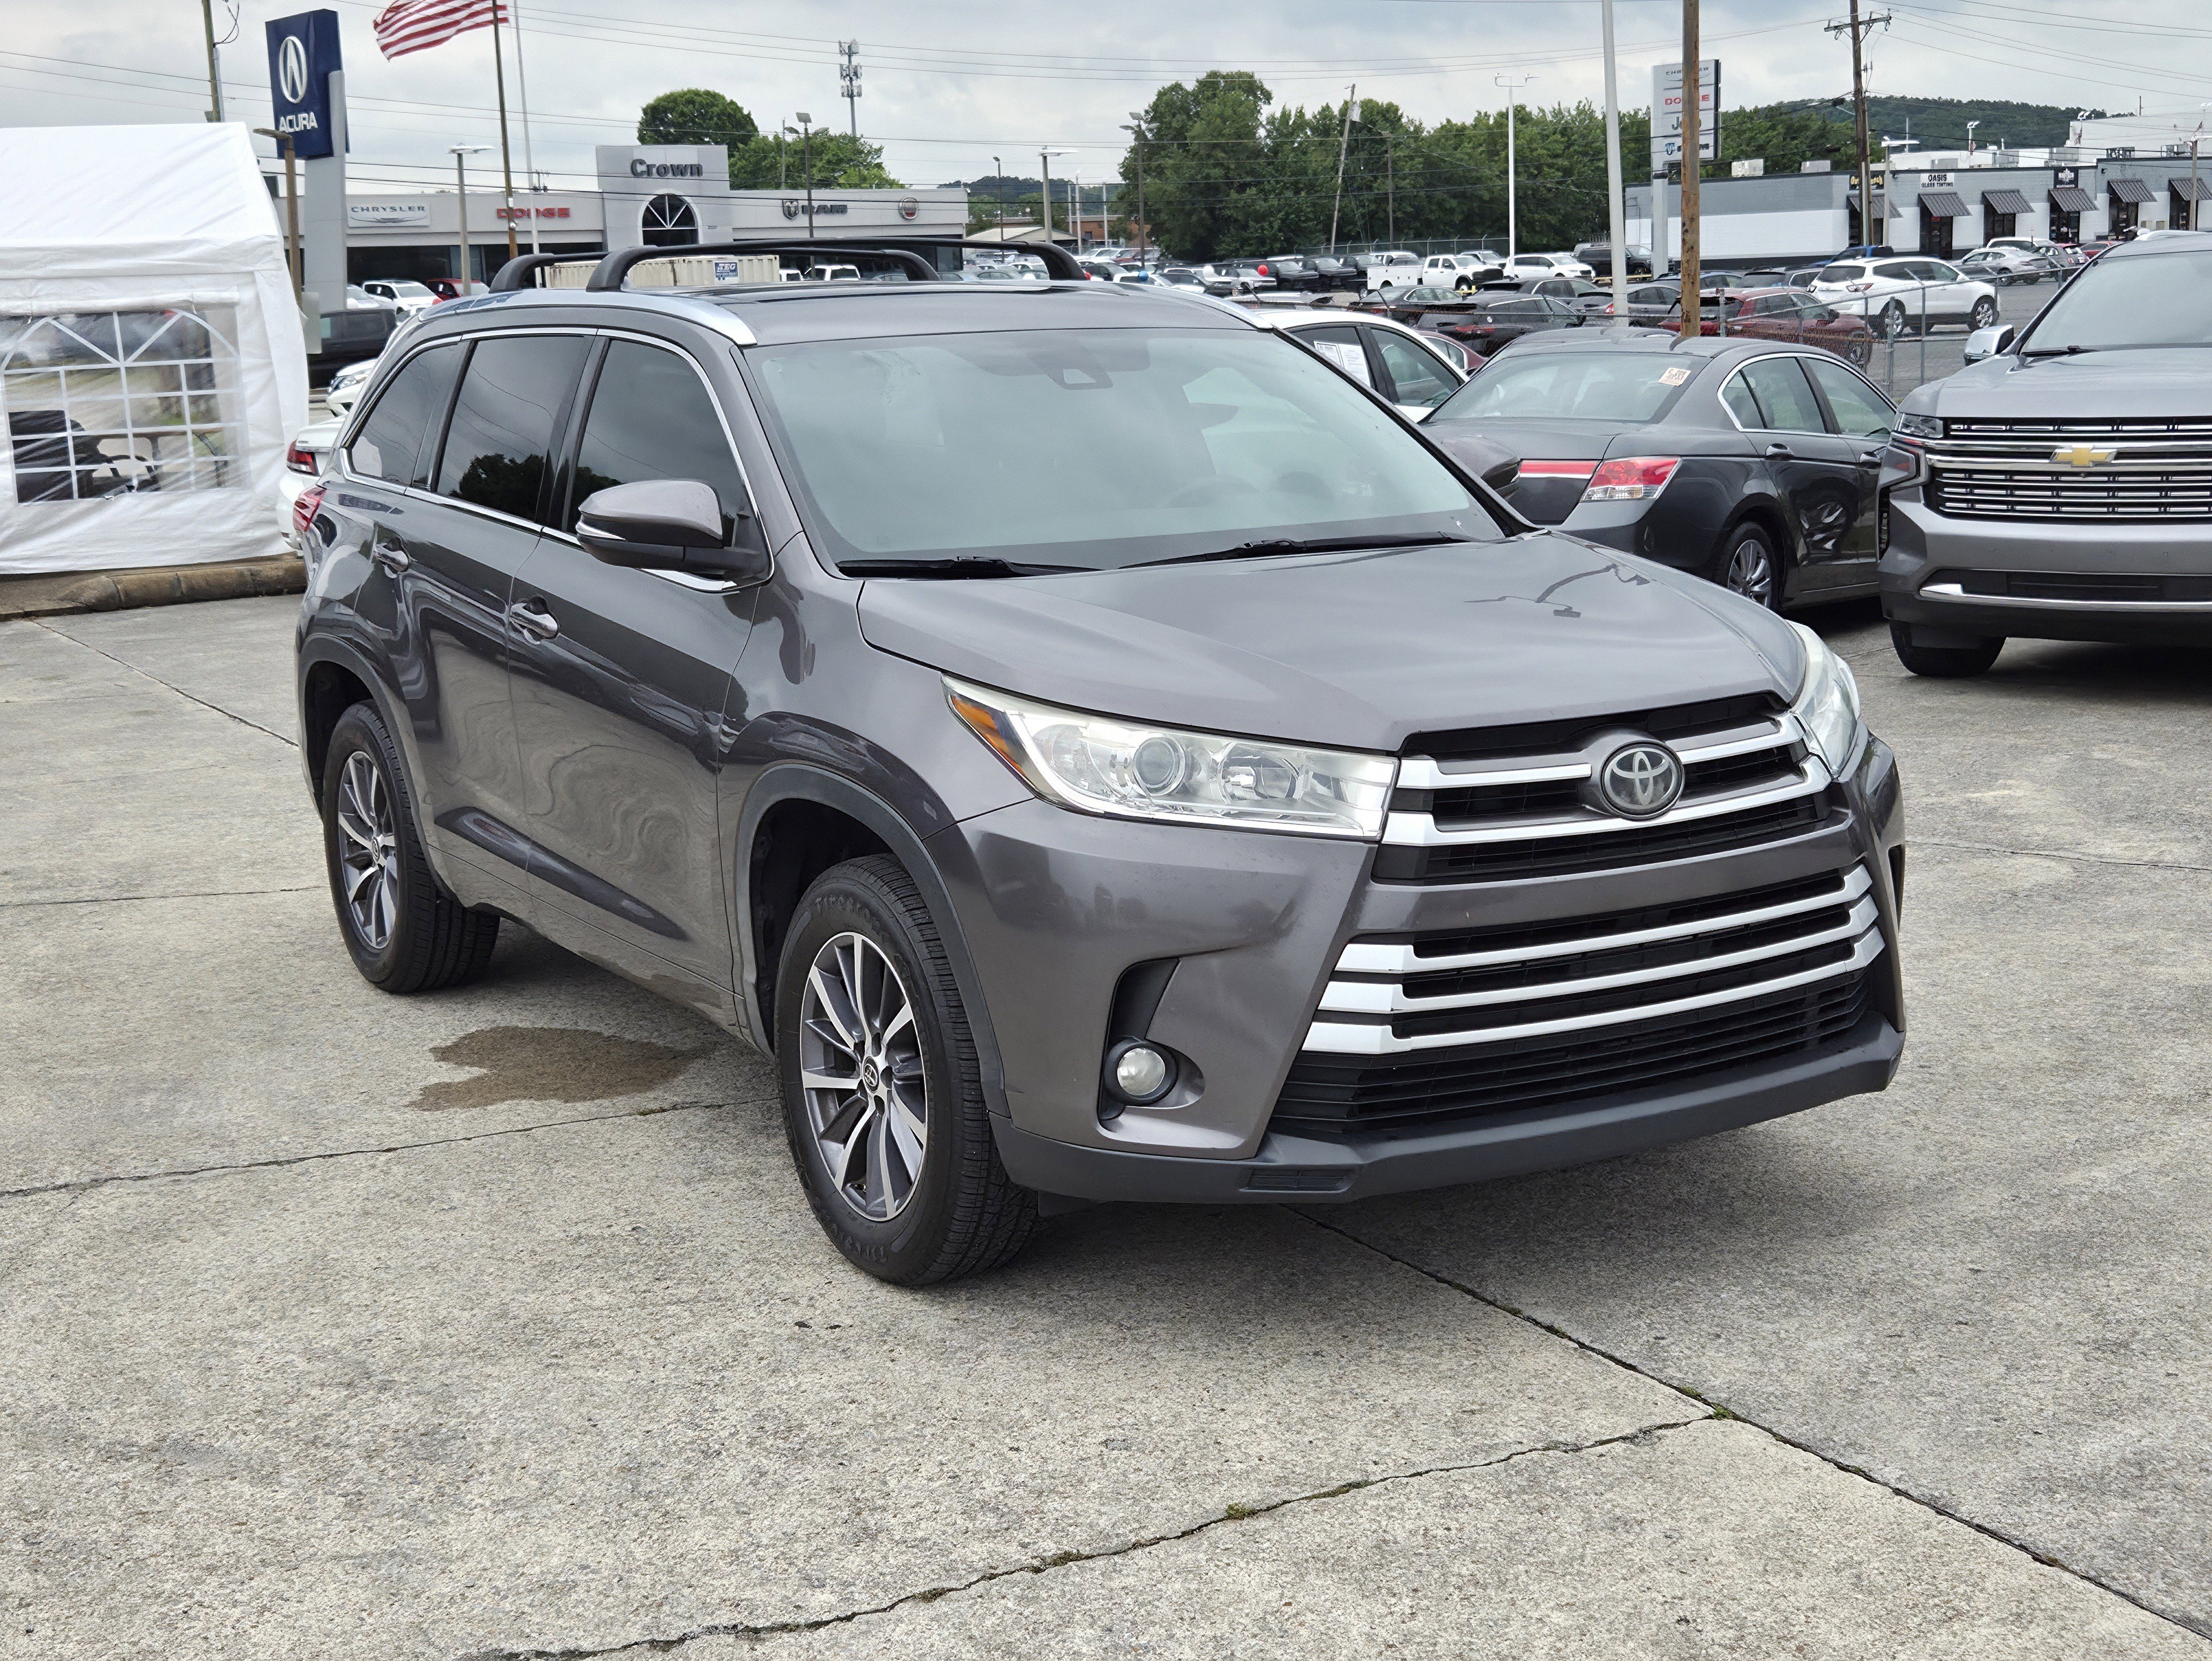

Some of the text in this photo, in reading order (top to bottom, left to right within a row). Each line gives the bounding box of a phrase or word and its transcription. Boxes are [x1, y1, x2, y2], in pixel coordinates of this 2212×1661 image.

[1665, 94, 1710, 106] DOE
[279, 112, 318, 133] ACURA
[631, 159, 703, 177] Crown
